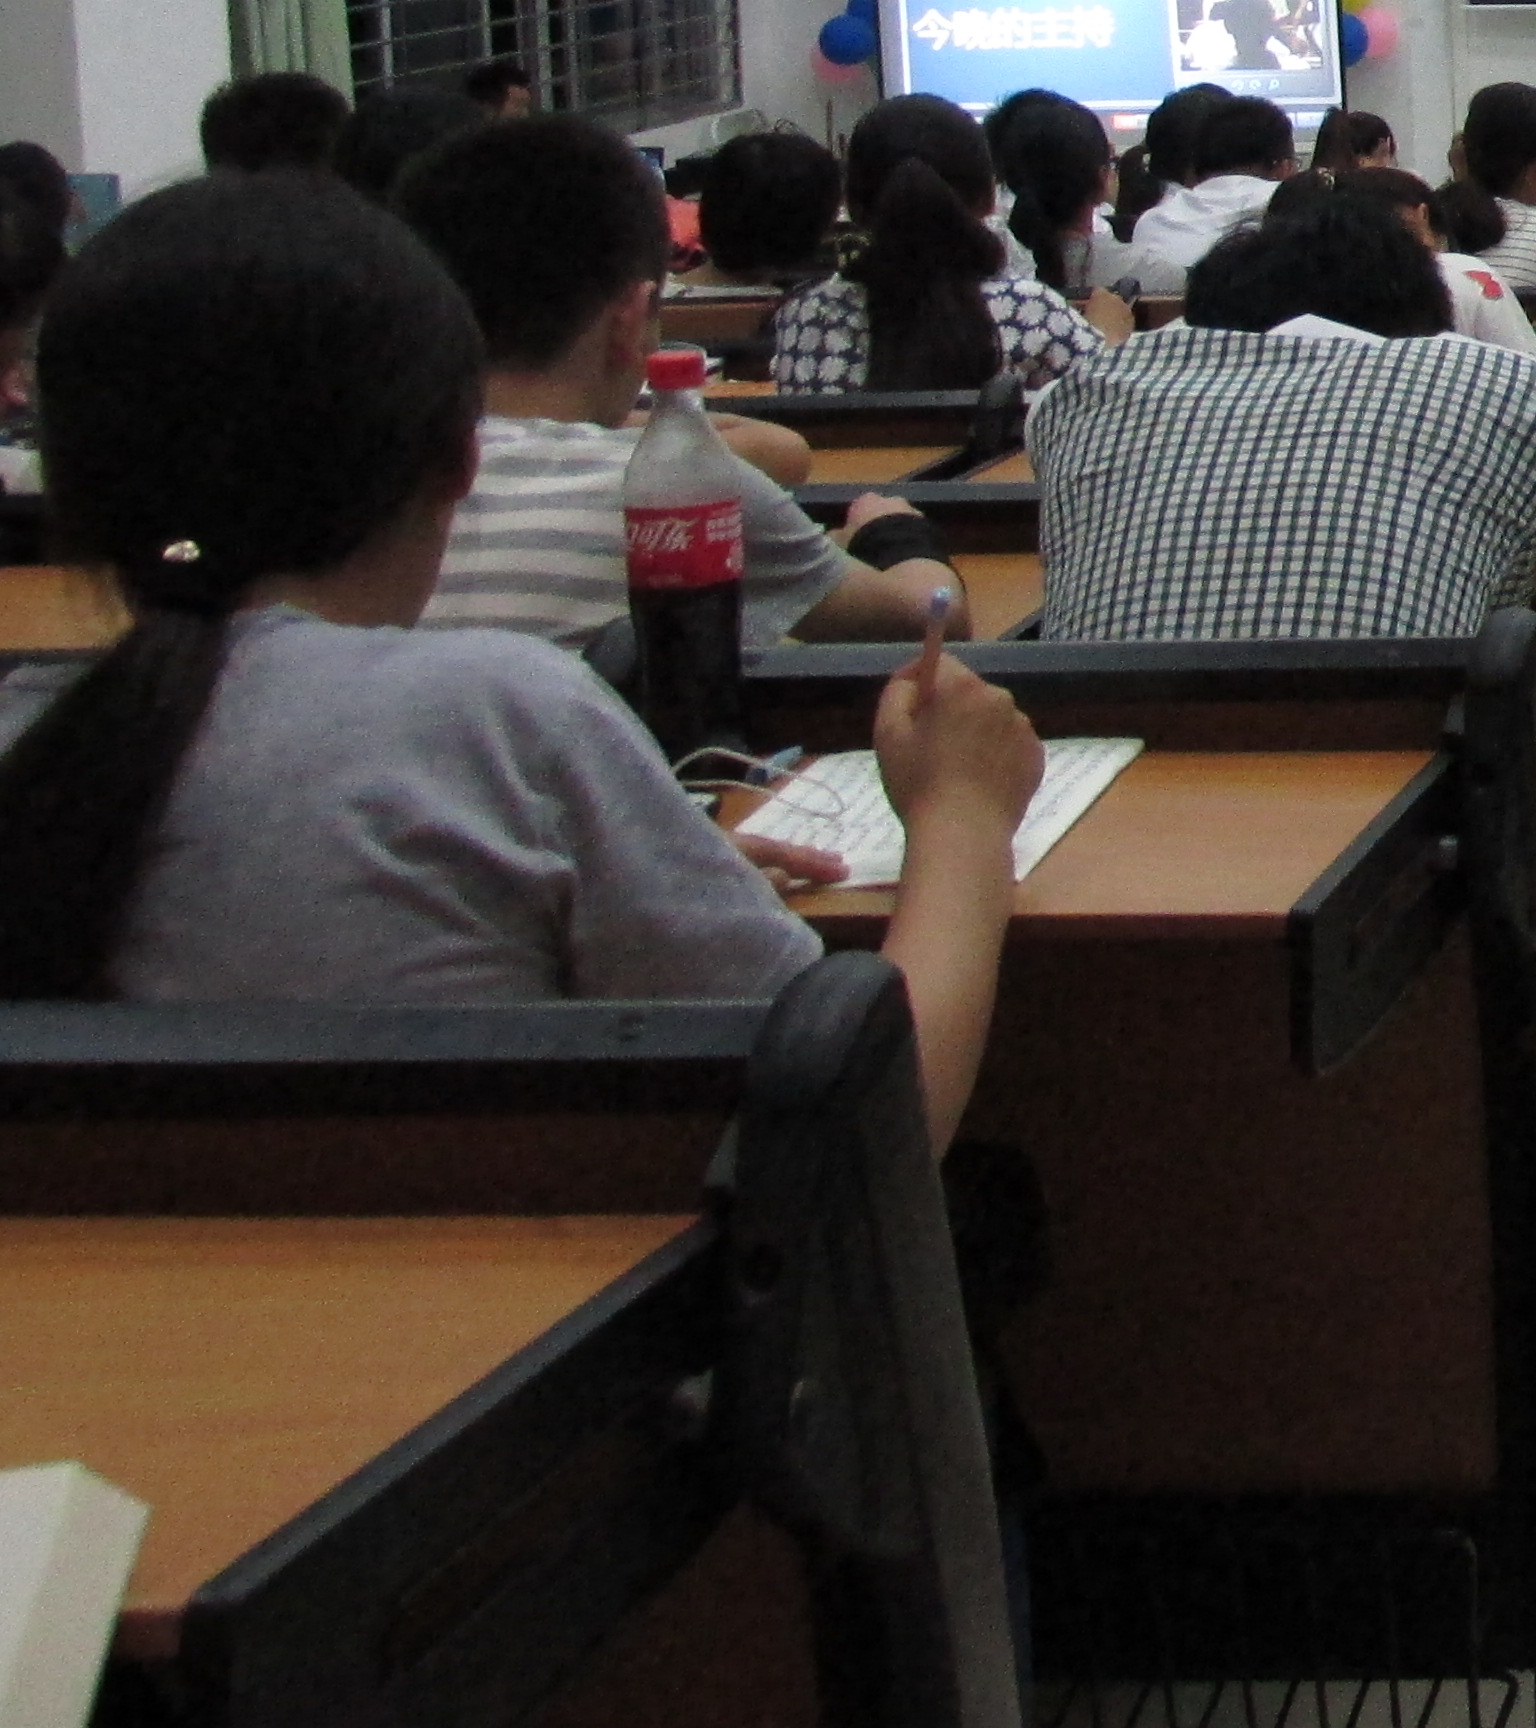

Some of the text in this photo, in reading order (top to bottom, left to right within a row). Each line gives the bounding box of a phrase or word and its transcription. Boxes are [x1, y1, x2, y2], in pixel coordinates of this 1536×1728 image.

[912, 5, 1115, 51] 今晚的主持
